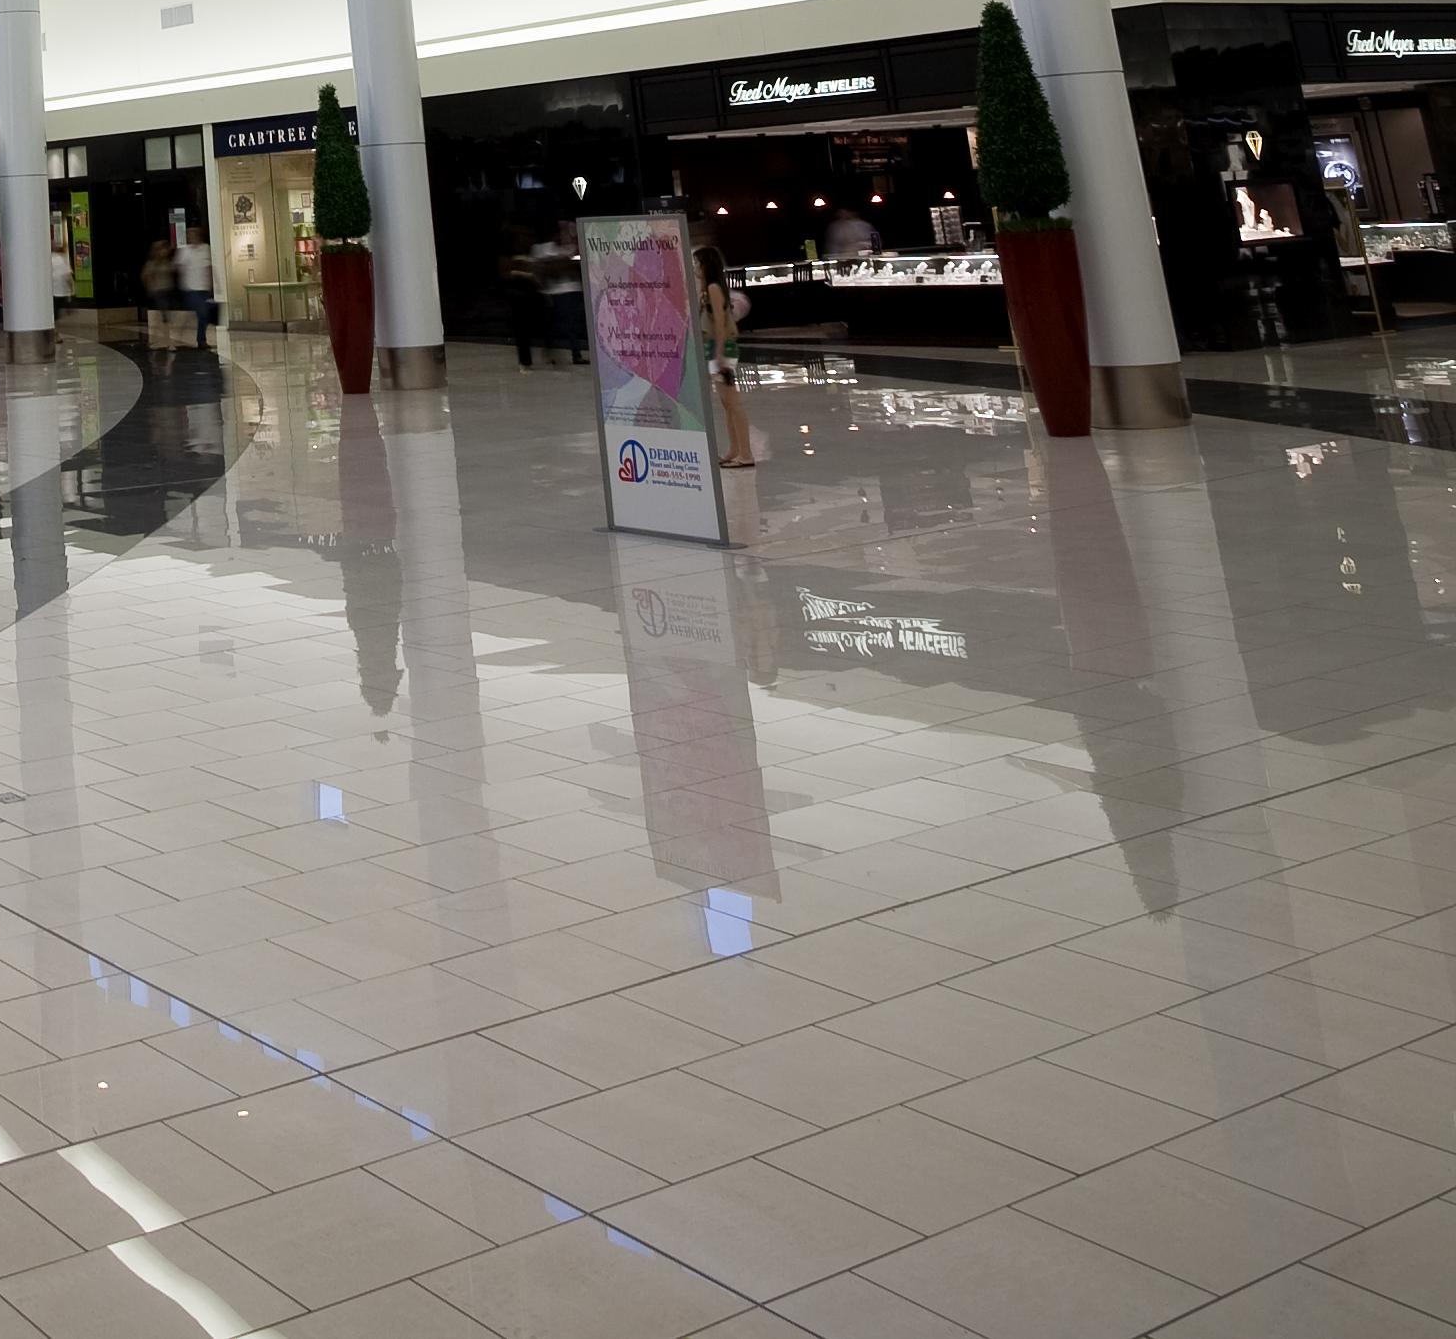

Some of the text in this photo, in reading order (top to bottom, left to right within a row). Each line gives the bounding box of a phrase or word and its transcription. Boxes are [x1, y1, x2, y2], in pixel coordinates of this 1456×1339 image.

[1346, 29, 1375, 53] Fred
[1375, 29, 1415, 58] Meyer
[729, 76, 875, 103] Fred Meyer JEWELERS
[228, 126, 307, 148] CRABTREE
[587, 235, 679, 256] Why wouldn't you?
[648, 447, 698, 464] DEBORAH
